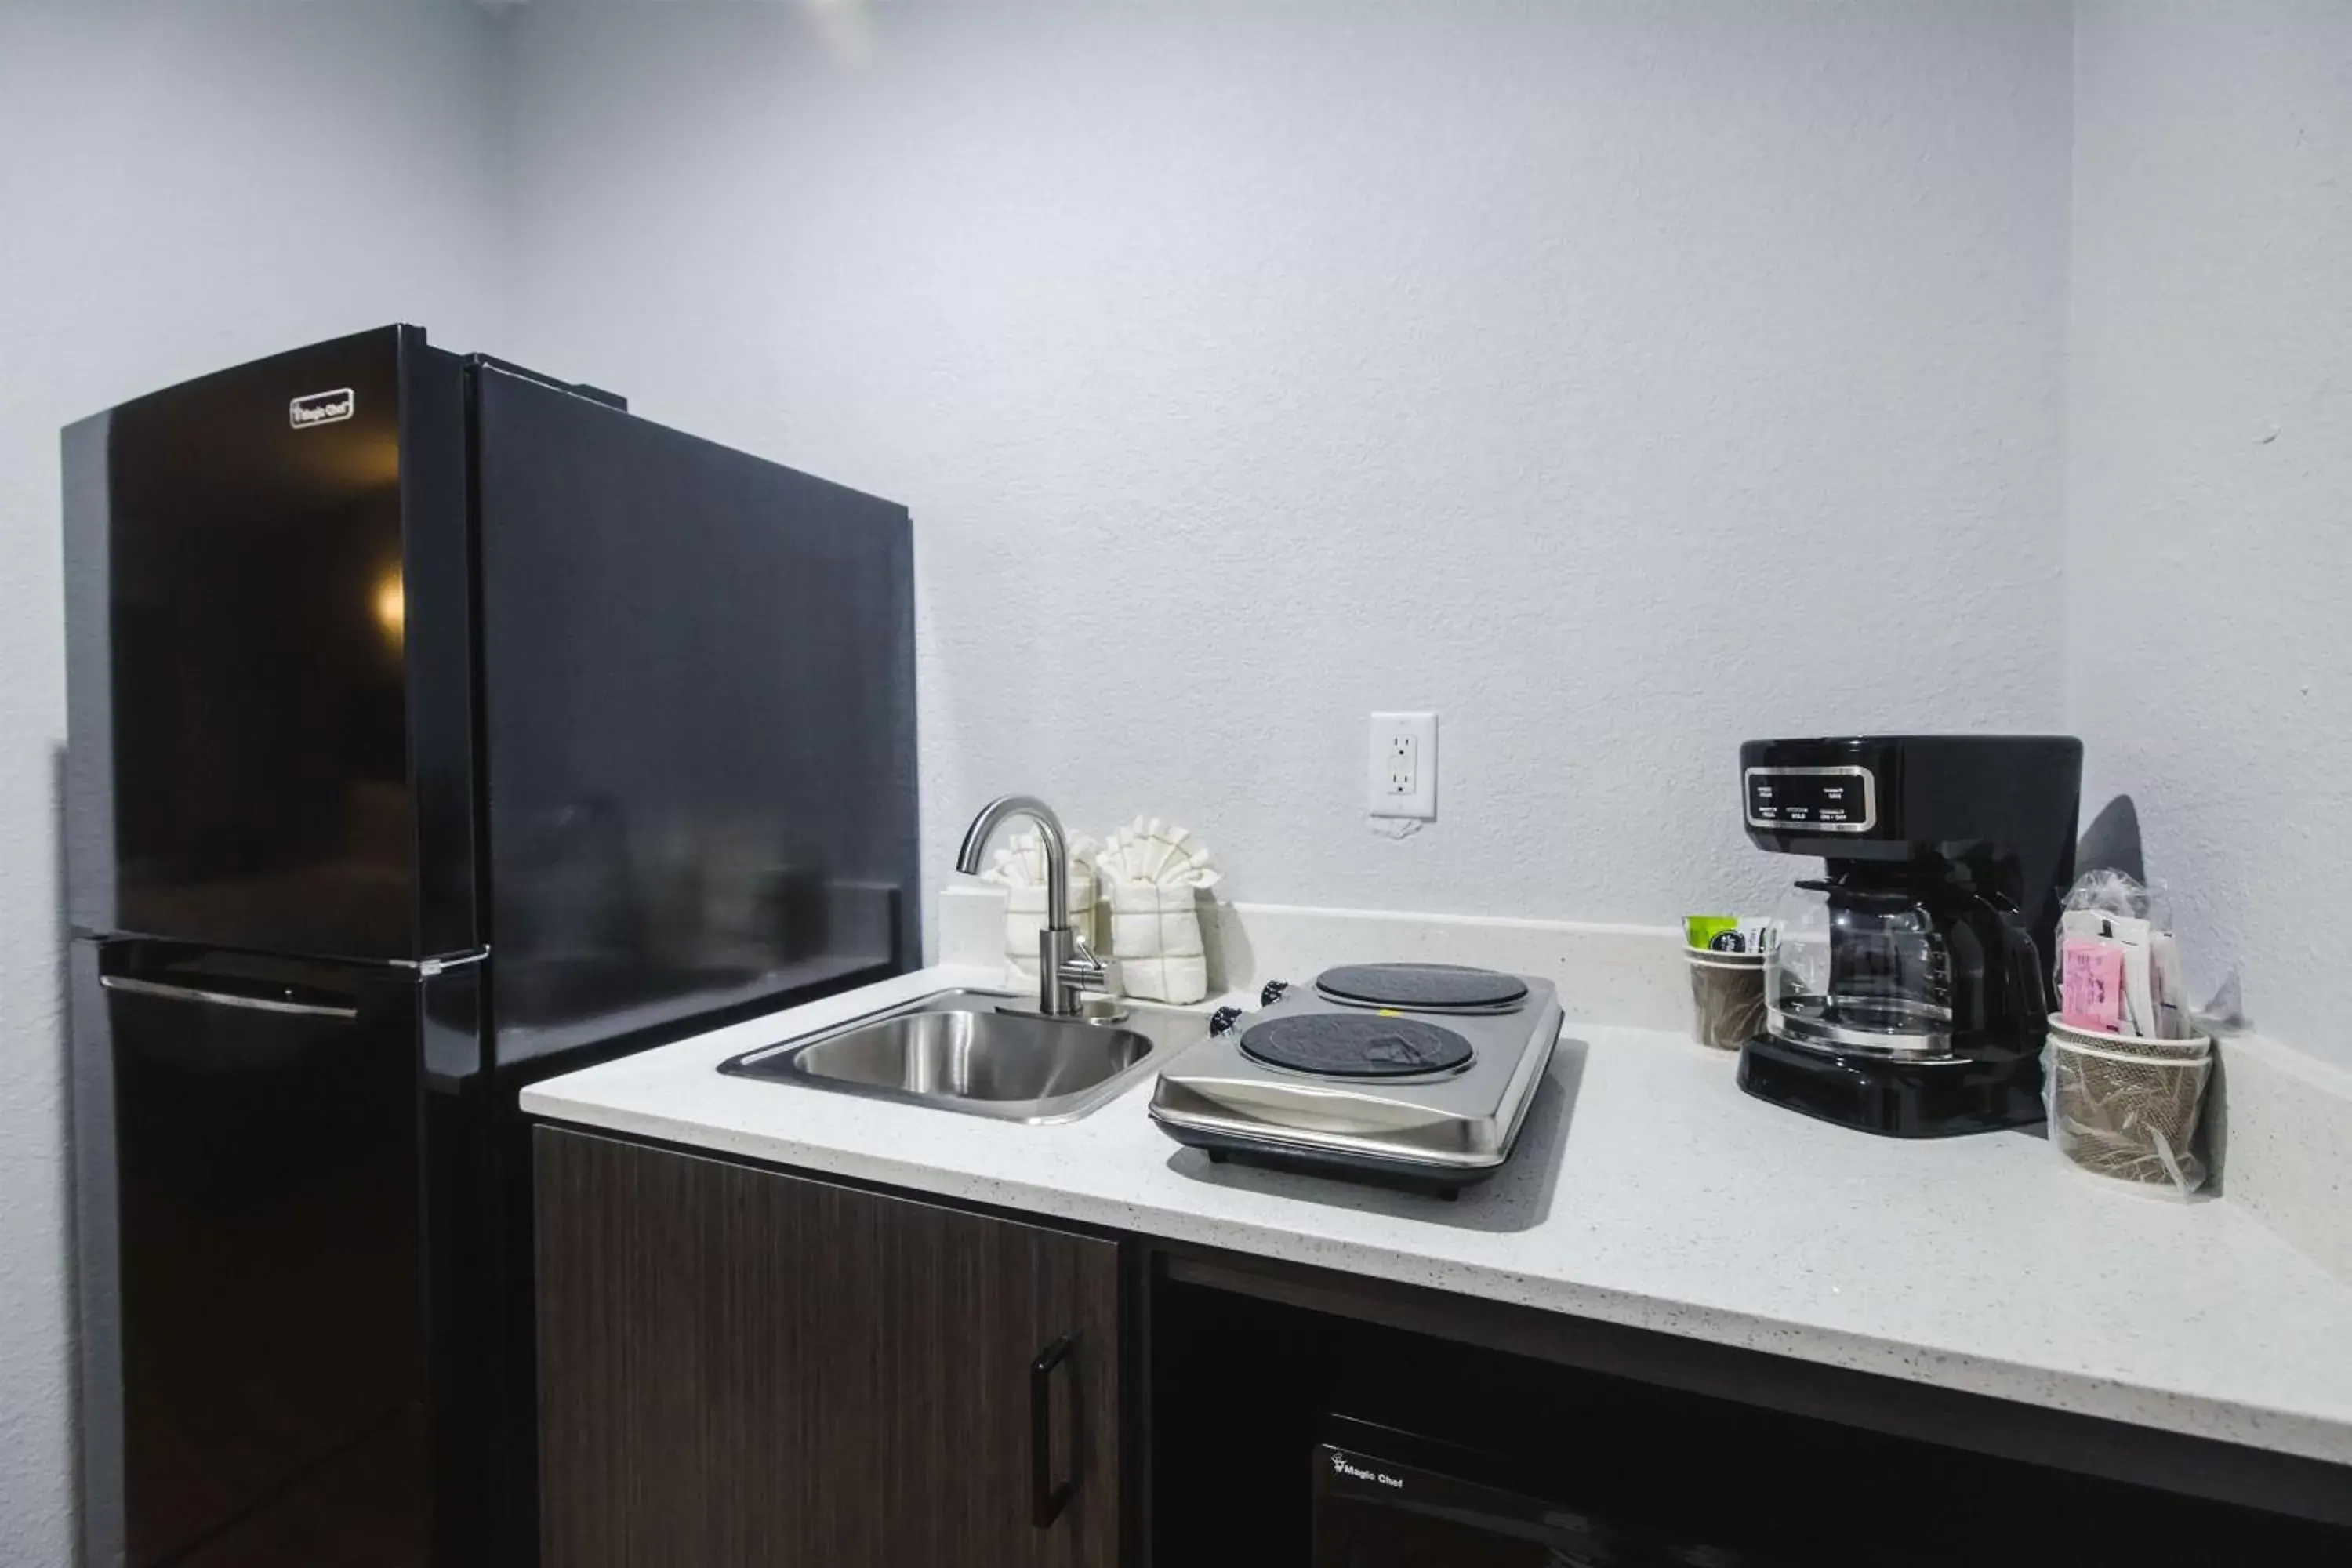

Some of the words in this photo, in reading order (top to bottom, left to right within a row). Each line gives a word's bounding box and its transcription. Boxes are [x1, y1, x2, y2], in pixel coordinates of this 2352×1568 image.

[301, 407, 325, 421] Magic
[1345, 1465, 1376, 1480] Magic
[1378, 1474, 1403, 1488] Chef
